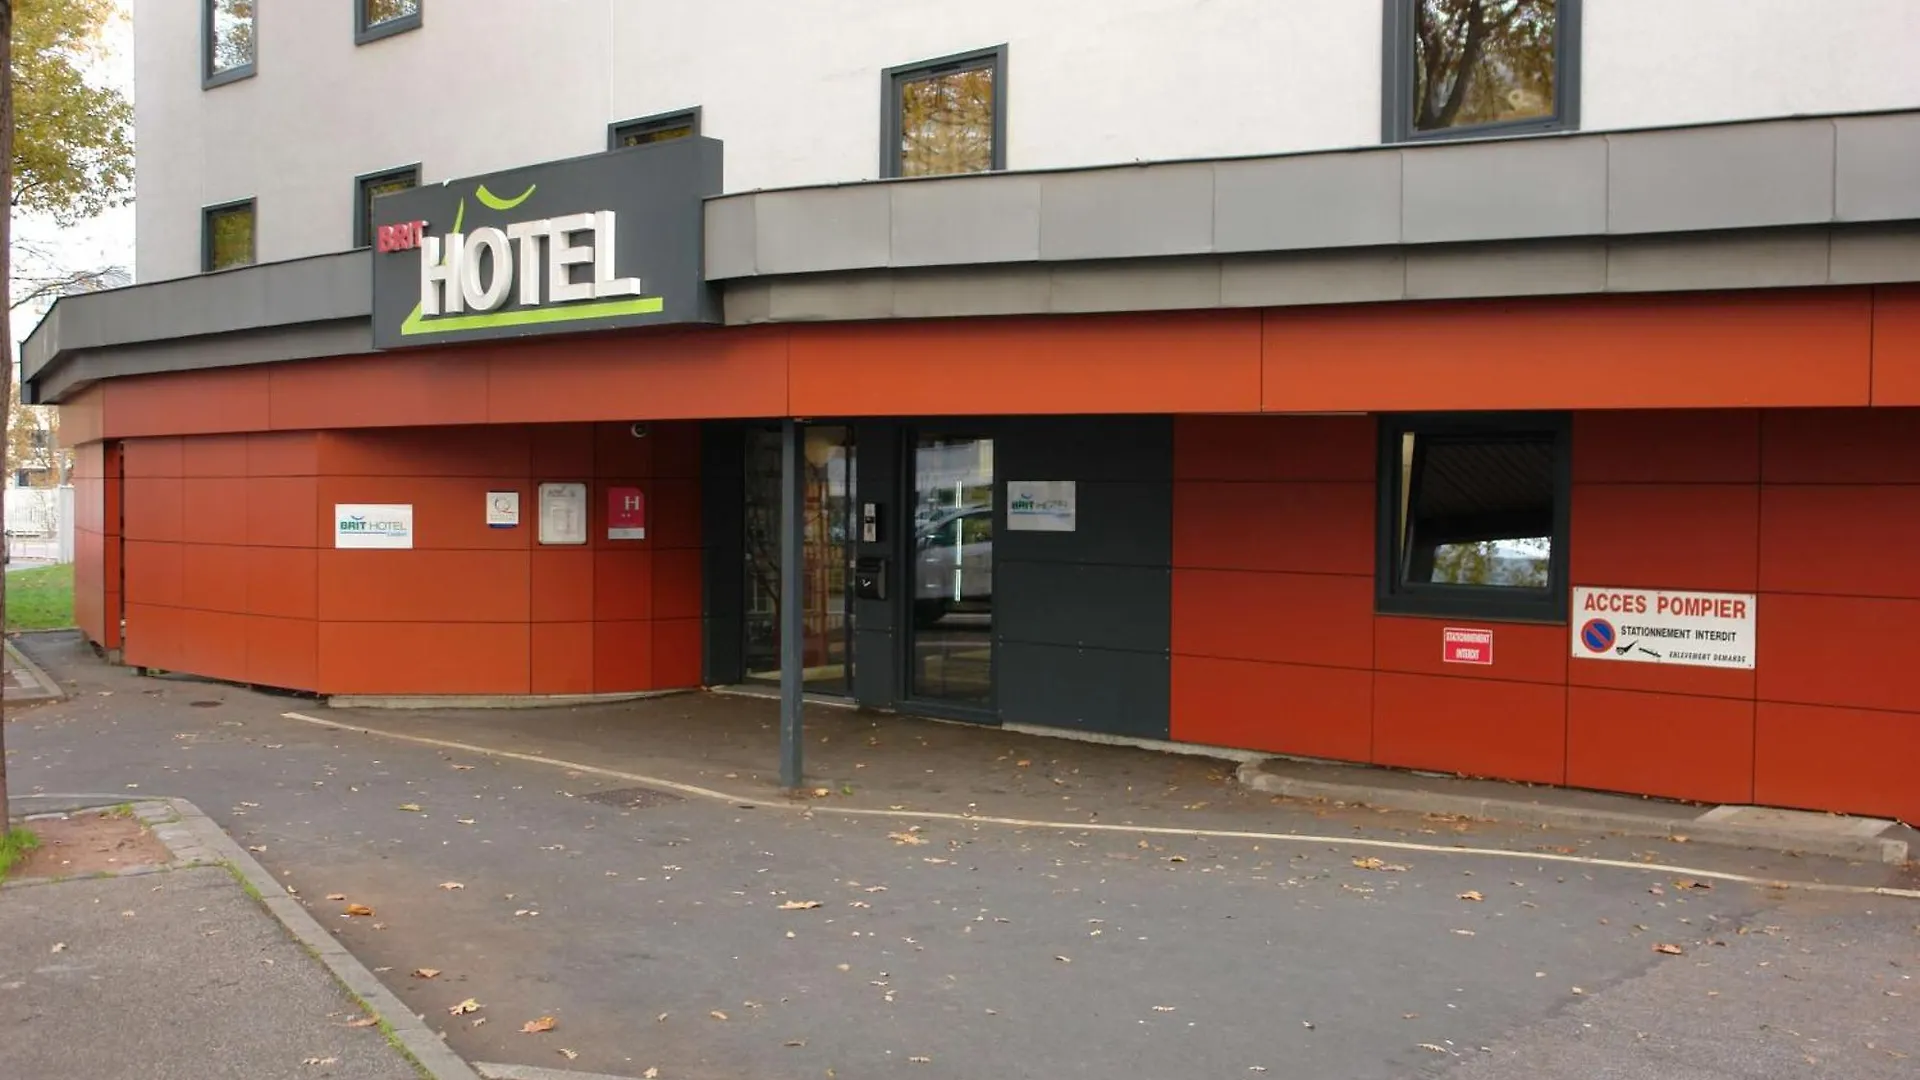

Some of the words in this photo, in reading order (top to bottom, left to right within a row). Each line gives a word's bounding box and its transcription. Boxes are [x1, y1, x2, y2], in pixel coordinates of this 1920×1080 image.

[378, 220, 429, 252] BRIT
[420, 210, 641, 315] HOTEL
[624, 495, 640, 511] H
[340, 521, 366, 530] BRIT
[369, 521, 408, 531] HOTEL
[1584, 593, 1647, 614] ACCES
[1657, 596, 1746, 619] POMPIER
[1620, 625, 1691, 640] STATIONNEMENT
[1695, 630, 1737, 642] INTERDIT
[1669, 651, 1711, 661] ENLEVEMENT
